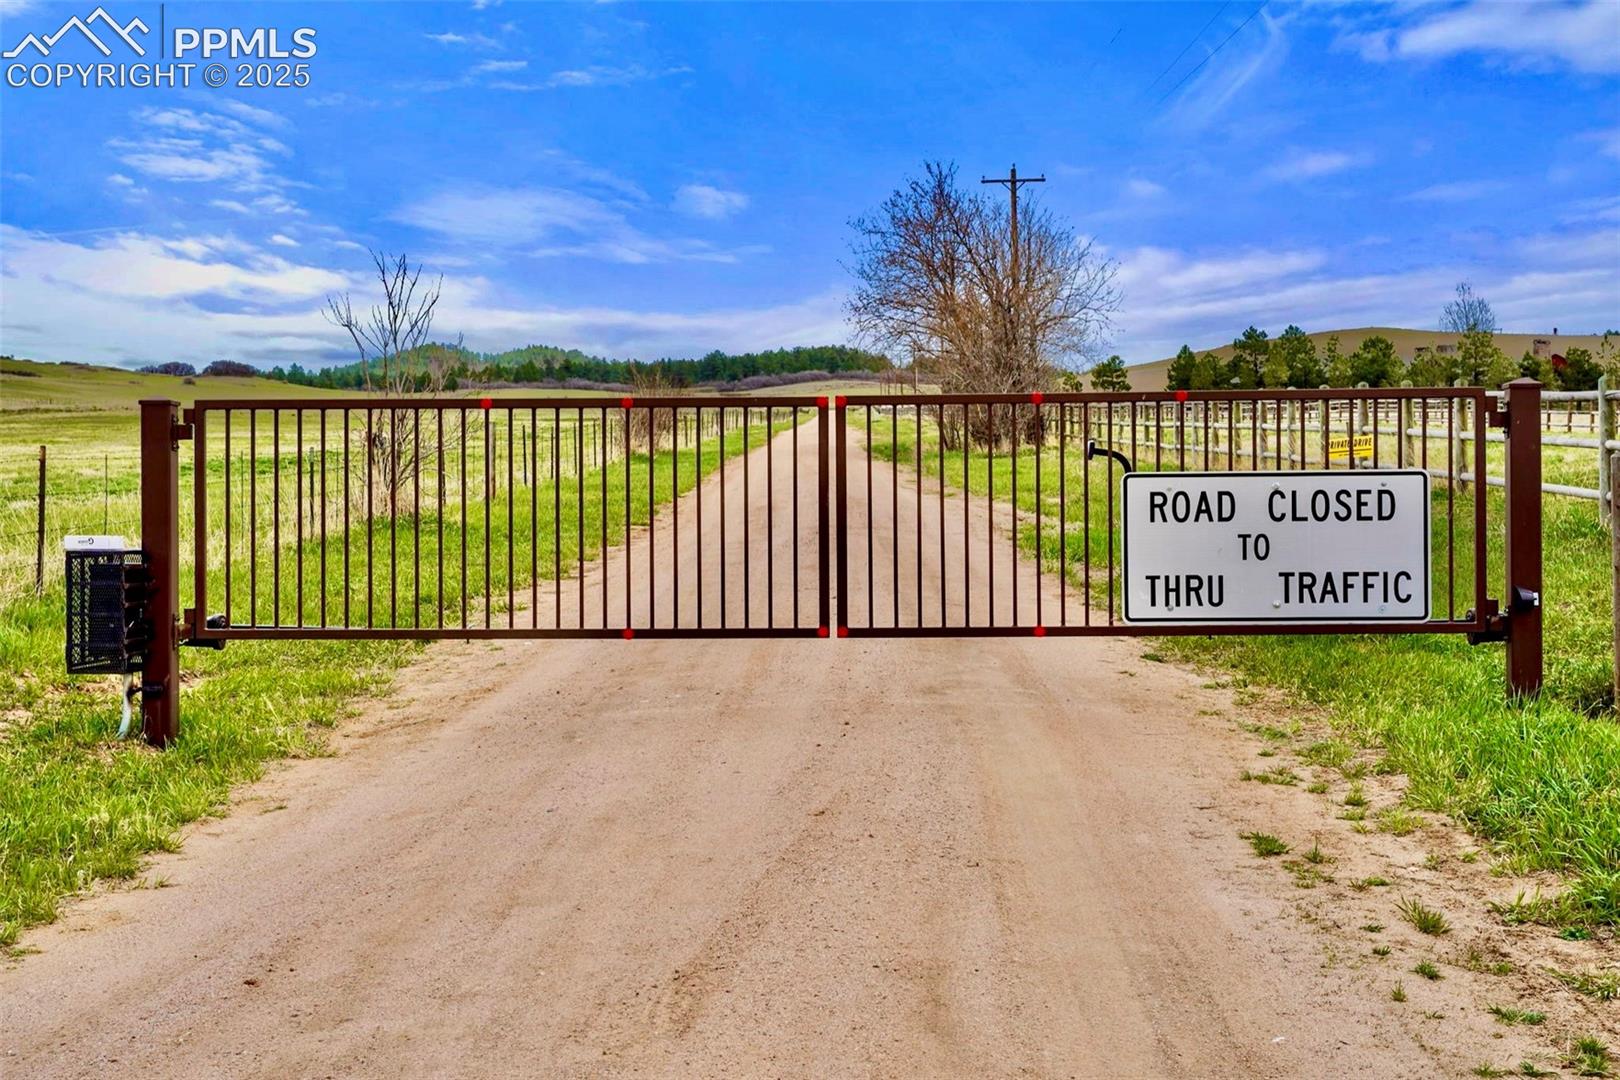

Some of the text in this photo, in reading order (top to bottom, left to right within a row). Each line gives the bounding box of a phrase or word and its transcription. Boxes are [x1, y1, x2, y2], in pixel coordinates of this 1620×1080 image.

[1328, 439, 1350, 449] RIVAT
[1149, 489, 1396, 523] ROAD CLOSED
[1237, 533, 1270, 561] TO
[1145, 570, 1412, 607] THRU TRAFFIC
